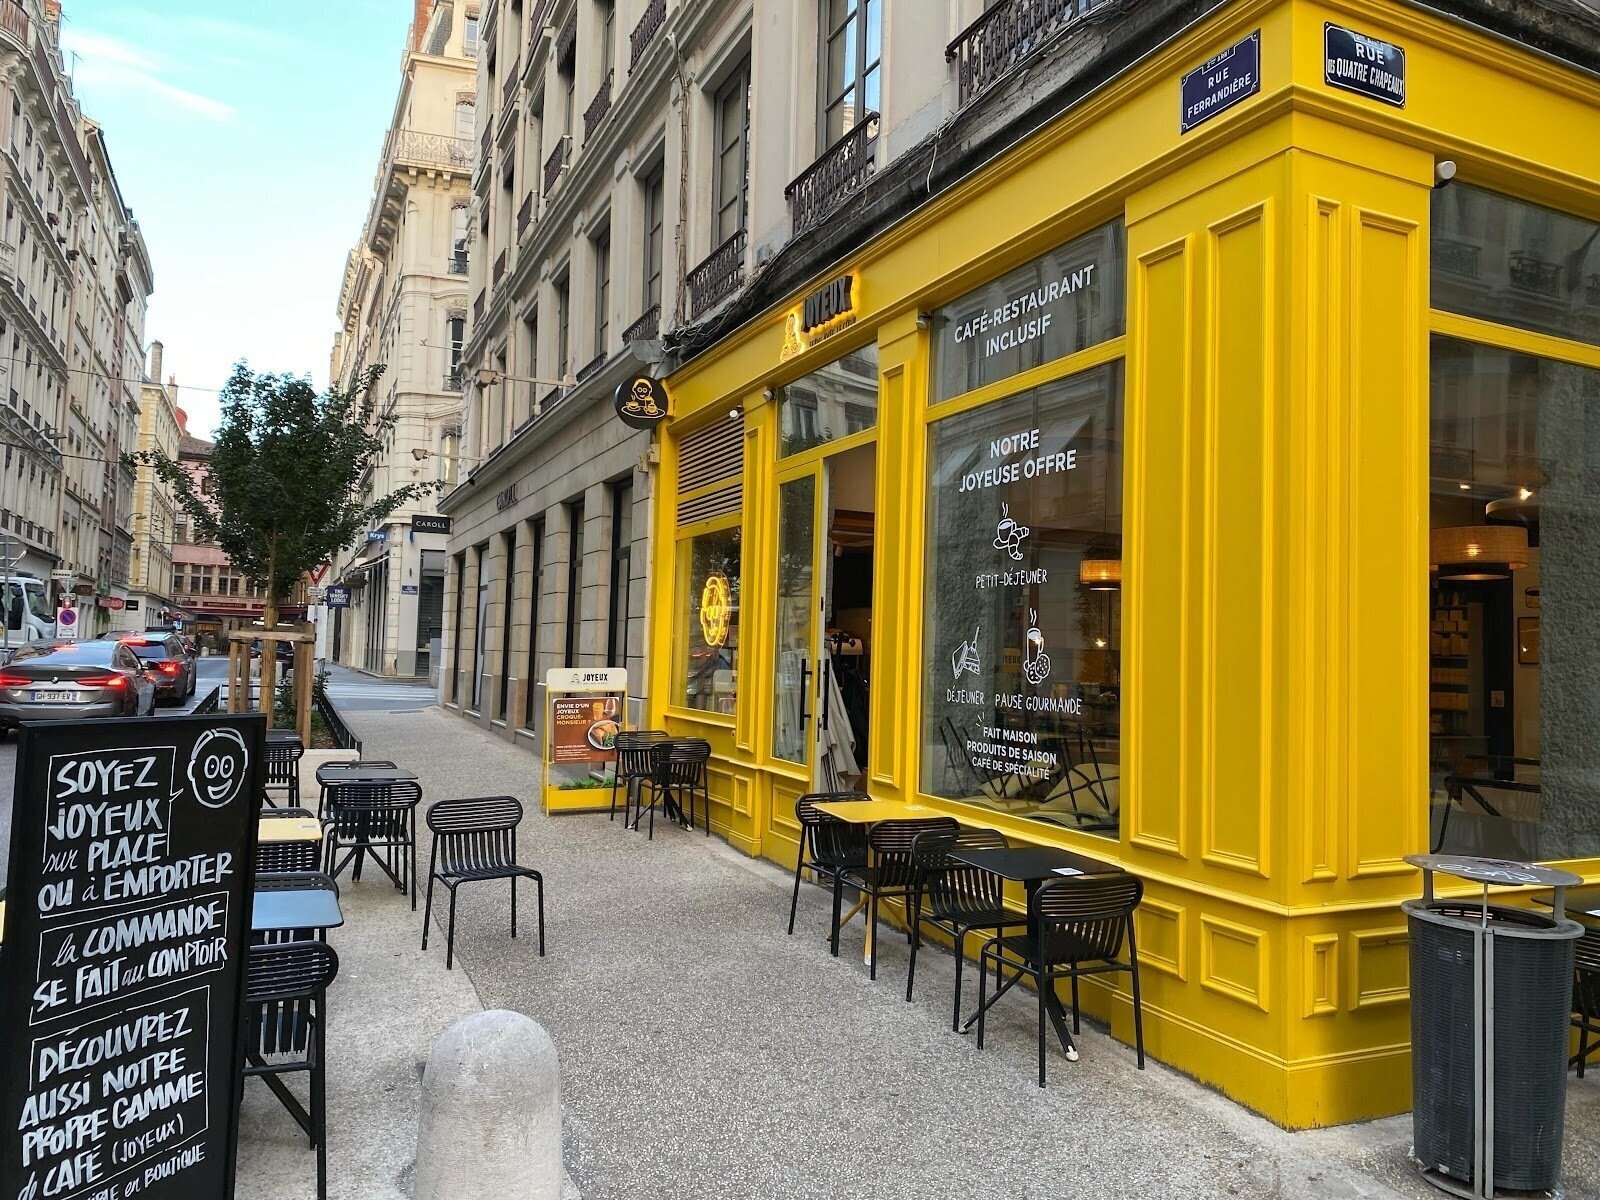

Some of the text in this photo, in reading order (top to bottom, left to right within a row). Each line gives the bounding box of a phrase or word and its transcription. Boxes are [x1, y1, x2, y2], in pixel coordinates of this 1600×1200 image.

[1356, 43, 1385, 65] RUE
[1187, 72, 1252, 119] FERRANDIÈRE
[1208, 67, 1229, 89] RUE
[1336, 58, 1369, 83] QUATRE
[1370, 67, 1404, 97] CHAPEAUX
[801, 276, 853, 333] JOYEUX
[953, 264, 1095, 345] CAFÉ-RESTAURANT
[985, 314, 1052, 358] INCLUSIF
[990, 428, 1040, 459] NOTRE
[958, 448, 1078, 493] JOYEUSE OFFRE
[369, 532, 385, 540] Krys
[415, 520, 446, 529] CAROLL
[975, 567, 1049, 589] PETIT-DÉJEUNER
[582, 673, 609, 682] JOYEUX
[946, 685, 985, 705] DÉJEUNER
[995, 692, 1082, 715] PAUSE GOURMANDE
[966, 740, 1057, 765] PRODUITS DE SAISON
[983, 726, 1038, 745] FAIT MAISON
[56, 757, 158, 798] SOYEZ
[972, 754, 1050, 780] CAFÉ DE SPÉCIALITÉ
[48, 799, 163, 841] JOYEUX
[42, 833, 168, 875] sur PLACE
[38, 852, 234, 912] OU à EMPORTER
[51, 900, 225, 967] la COMMANDE
[33, 936, 229, 1012] SE FAIT au COMPTOIR
[18, 1047, 187, 1131] AUSSI NOTRE
[22, 1071, 204, 1168] PROPRE GAMME
[42, 1144, 104, 1198] CAFÉ
[124, 1177, 142, 1198] en
[144, 1142, 207, 1188] BOUTIQUE
